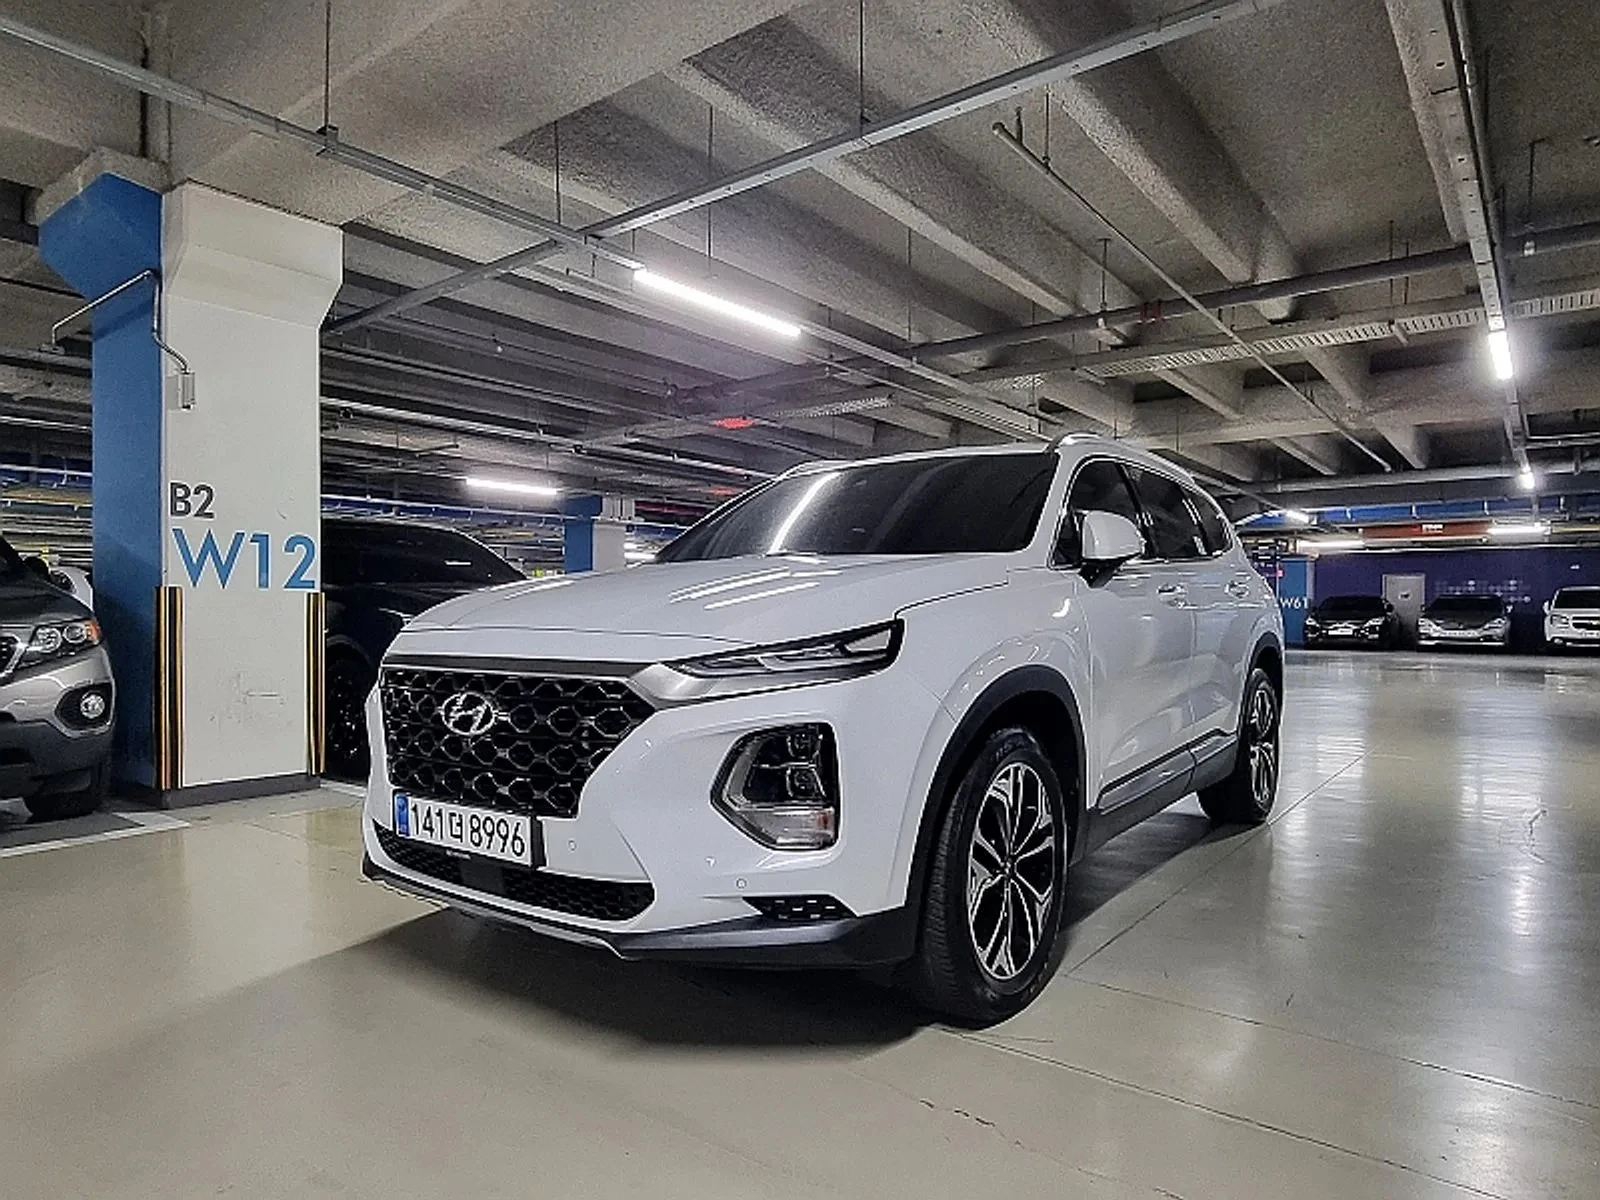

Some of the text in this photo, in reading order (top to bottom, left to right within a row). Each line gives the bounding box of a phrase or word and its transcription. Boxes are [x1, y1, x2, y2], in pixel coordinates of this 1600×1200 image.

[170, 482, 215, 519] B2
[171, 528, 316, 590] W12
[1280, 596, 1309, 609] W61
